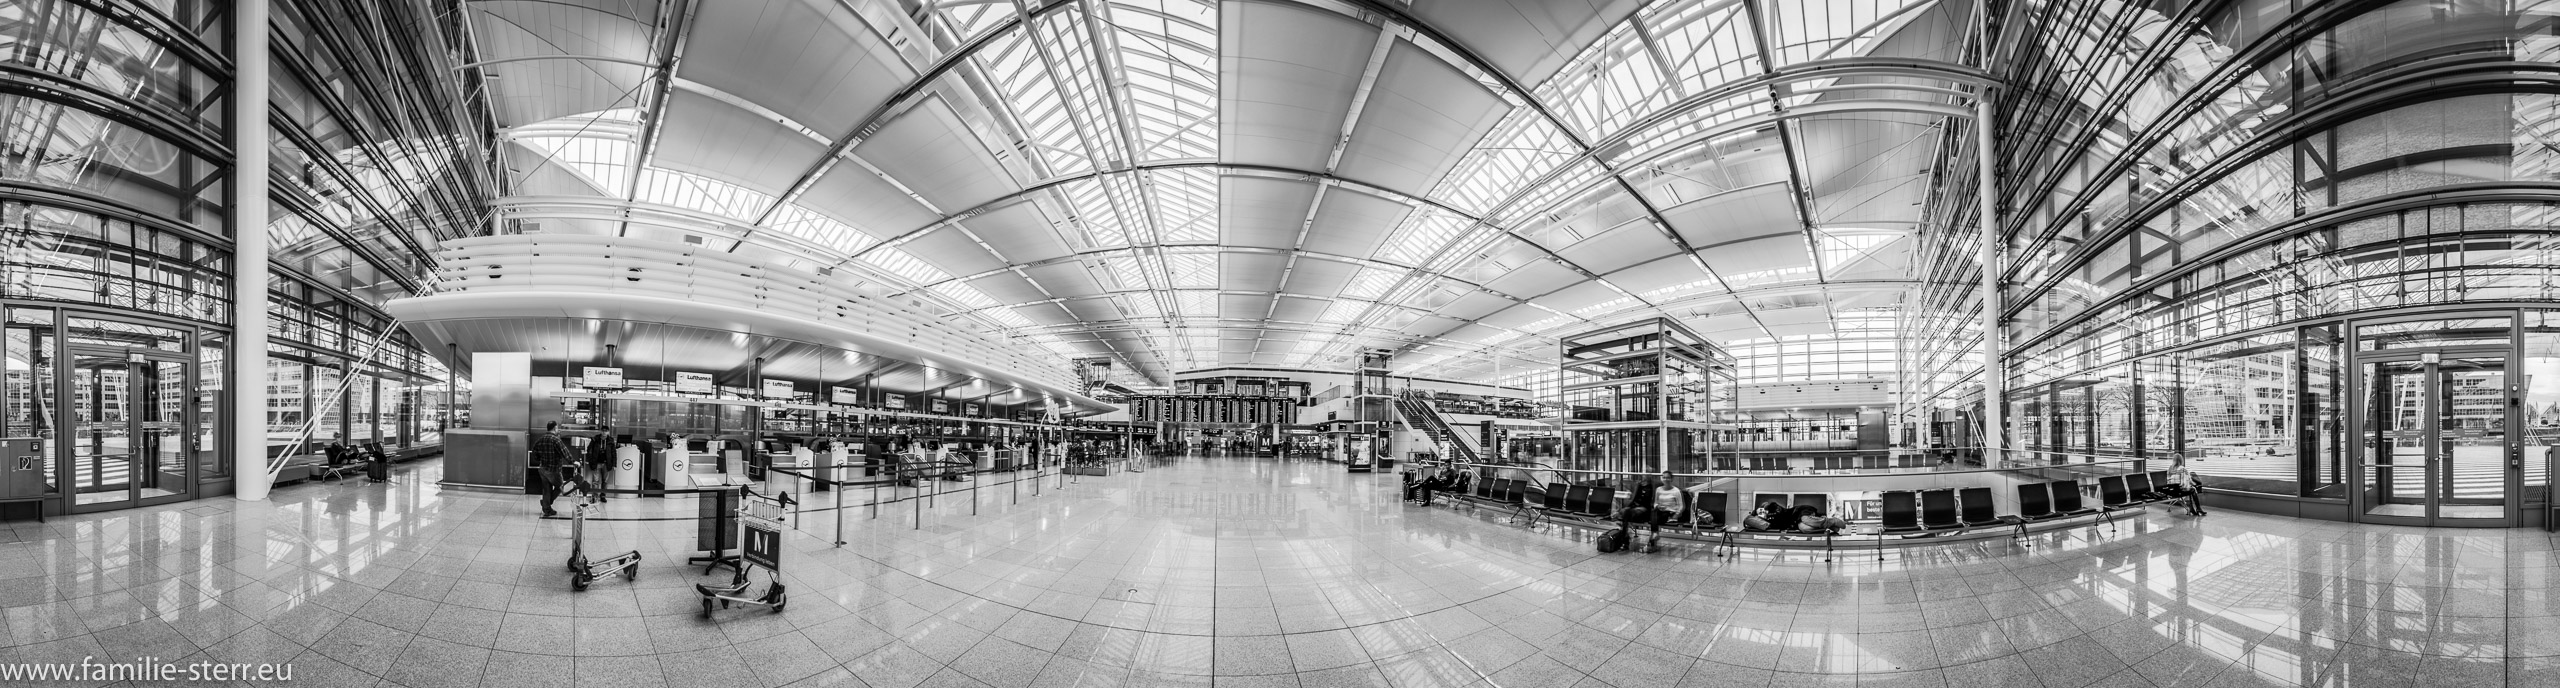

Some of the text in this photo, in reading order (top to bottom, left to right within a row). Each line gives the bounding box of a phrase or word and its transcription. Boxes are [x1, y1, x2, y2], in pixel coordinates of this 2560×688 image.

[687, 374, 711, 382] Lufthansa
[1262, 437, 1270, 446] M
[1845, 501, 1862, 519] M
[754, 531, 768, 555] M
